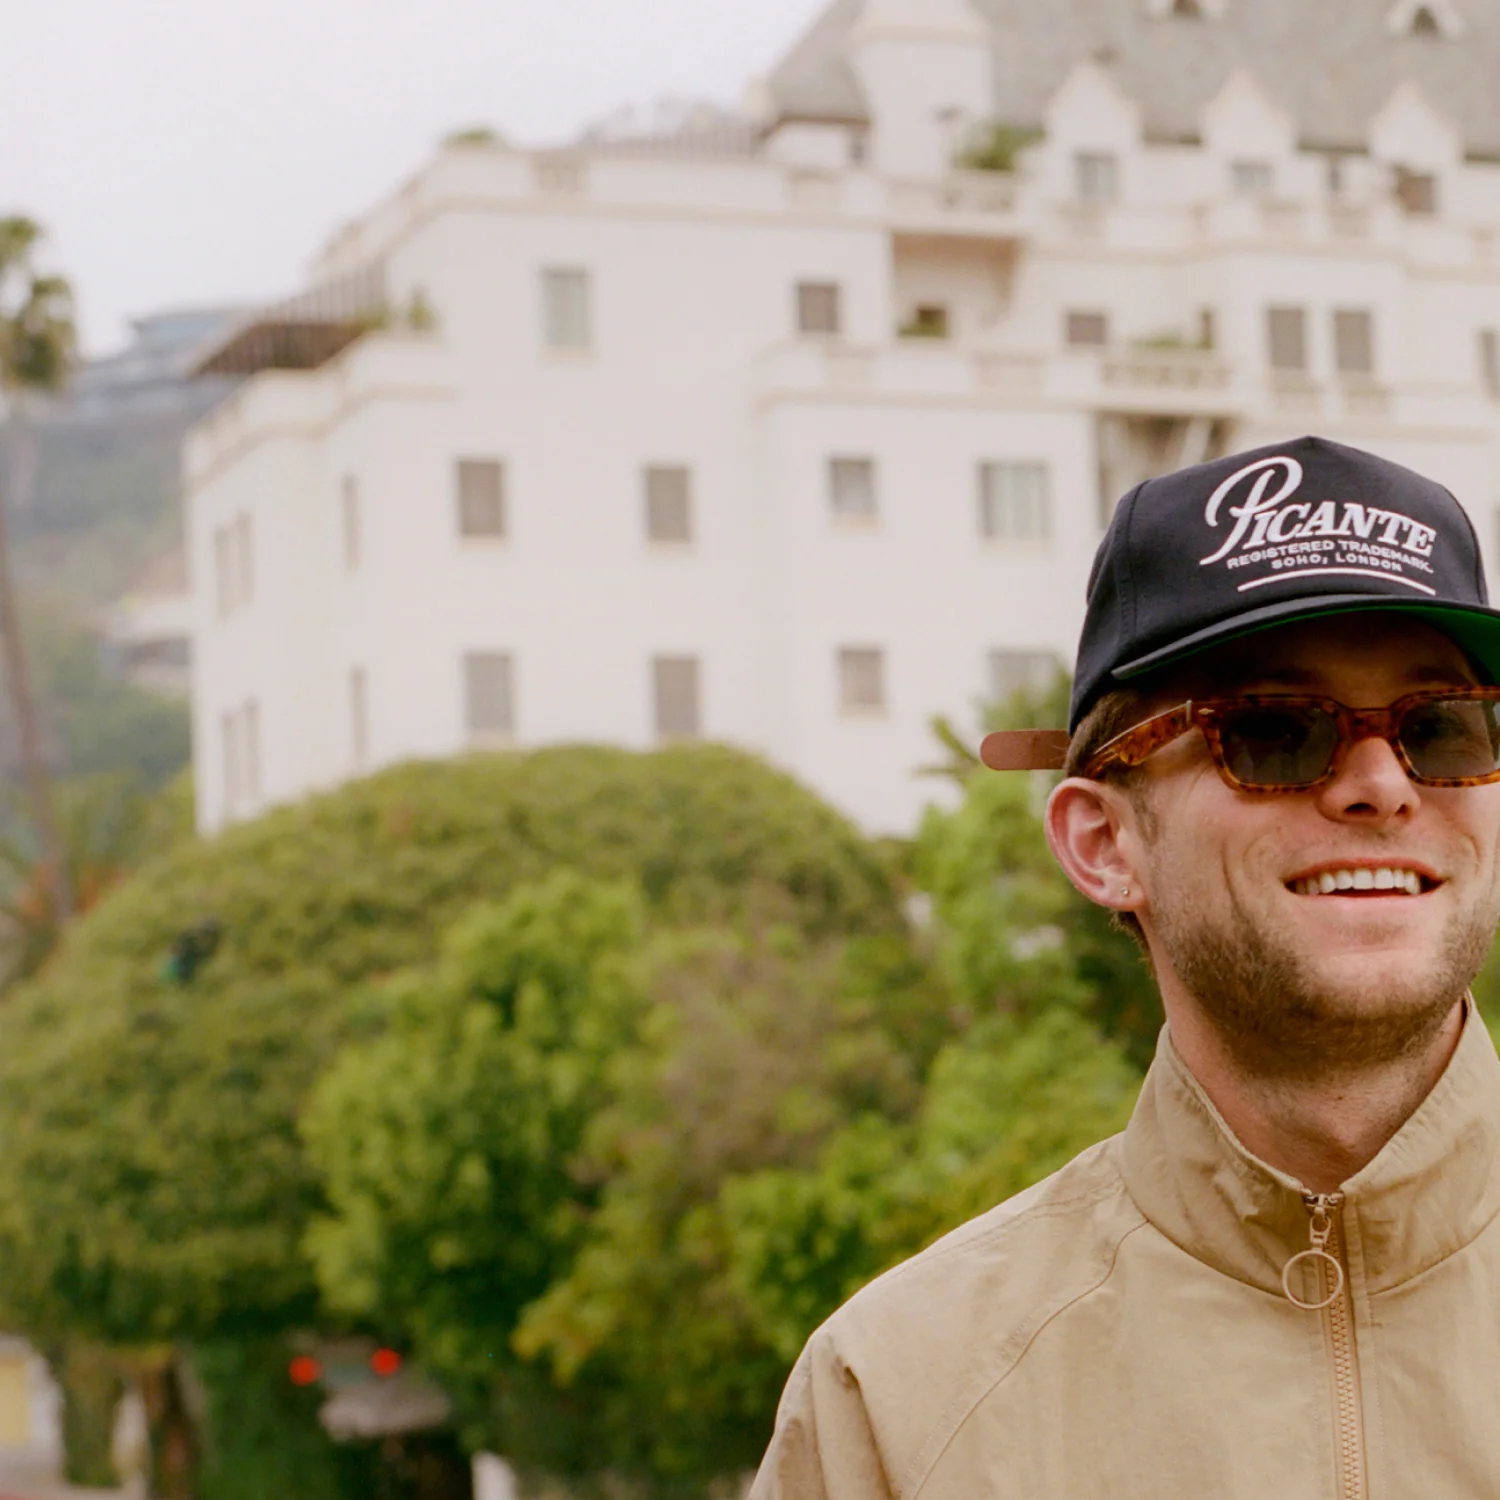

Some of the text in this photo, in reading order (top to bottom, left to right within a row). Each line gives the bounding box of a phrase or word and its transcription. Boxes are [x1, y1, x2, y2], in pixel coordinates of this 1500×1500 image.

[1199, 456, 1437, 565] PICANTE
[1227, 540, 1335, 569] REGISTERED
[1271, 552, 1403, 572] SOHO, LONDON
